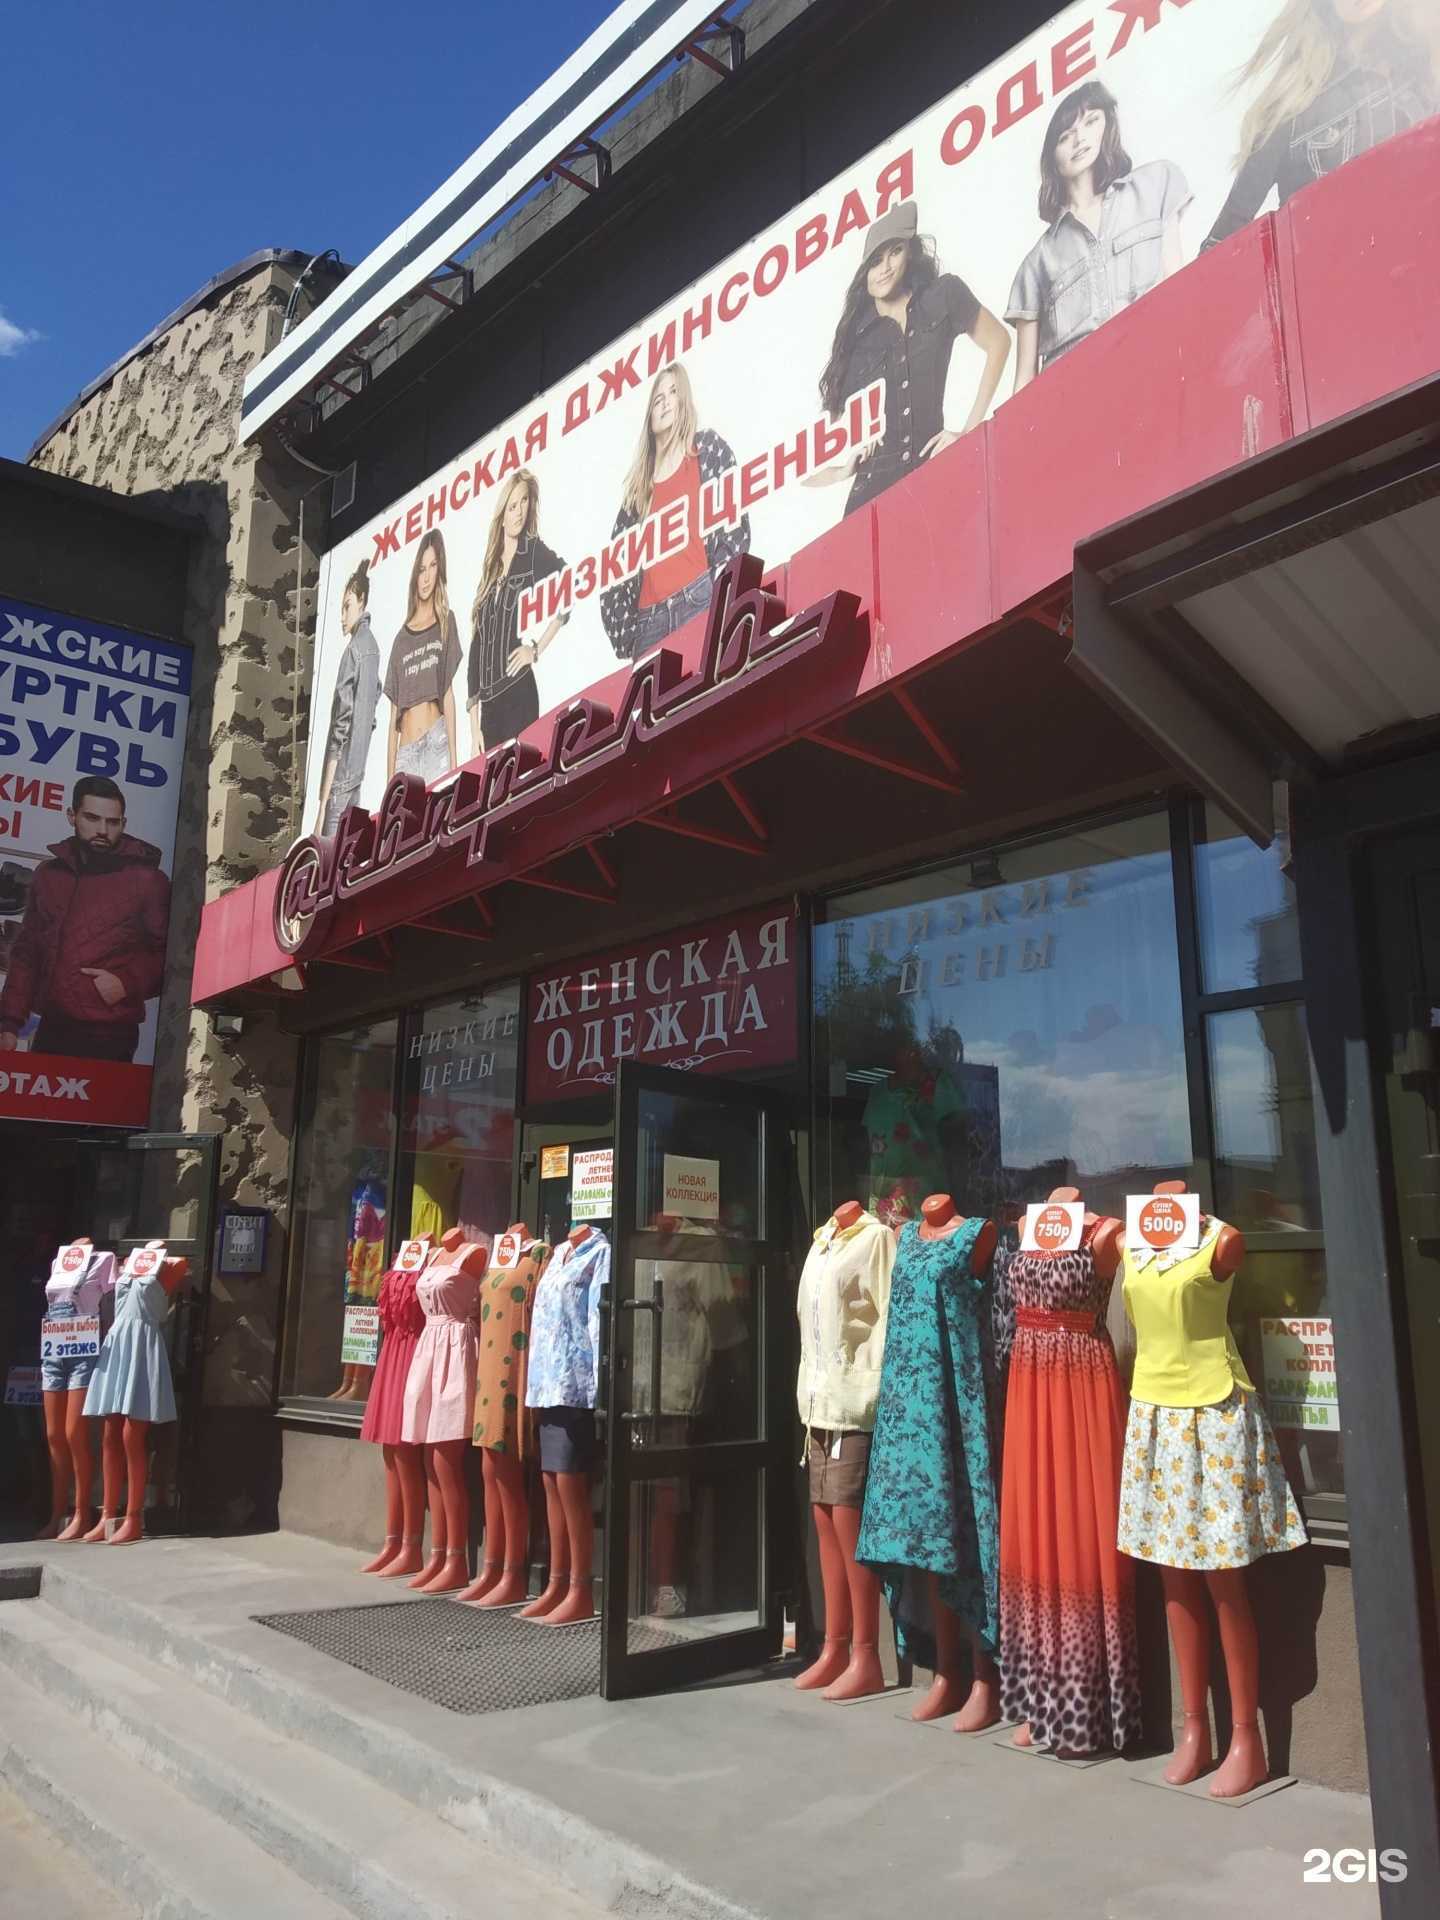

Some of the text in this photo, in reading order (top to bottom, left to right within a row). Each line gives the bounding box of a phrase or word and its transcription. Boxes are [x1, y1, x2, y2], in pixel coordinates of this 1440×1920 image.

[370, 412, 548, 569] ЖЕНСКАЯ
[561, 148, 914, 436] ДЖИНСОВАЯ
[520, 385, 882, 632] НИЗКИЕ ЦЕНЫ!
[1, 613, 181, 686] ЖСКИЕ
[868, 869, 1093, 951] НИЗКИЕ
[533, 916, 790, 1024] ЖЕНСКАЯ
[897, 930, 1057, 995] ЦЕНЫ
[408, 1014, 514, 1060] НИЗКИЕ
[546, 984, 768, 1075] ОДЕЖДА
[422, 1052, 497, 1095] ЦЕНЫ
[574, 1151, 614, 1165] РАСПРОД
[588, 1165, 614, 1176] ЛЕТНЕ
[581, 1174, 613, 1186] КОЛЛЕКЦ
[678, 1174, 706, 1187] НОВАЯ
[666, 1188, 718, 1201] КОЛЛЕКЦИЯ
[1037, 1223, 1070, 1240] 750р
[1143, 1216, 1184, 1234] 500р
[43, 1321, 75, 1334] Большой
[1263, 1321, 1336, 1337] РАСПР
[43, 1341, 98, 1357] 2 этаже
[1286, 1359, 1337, 1373] КОЛЛ
